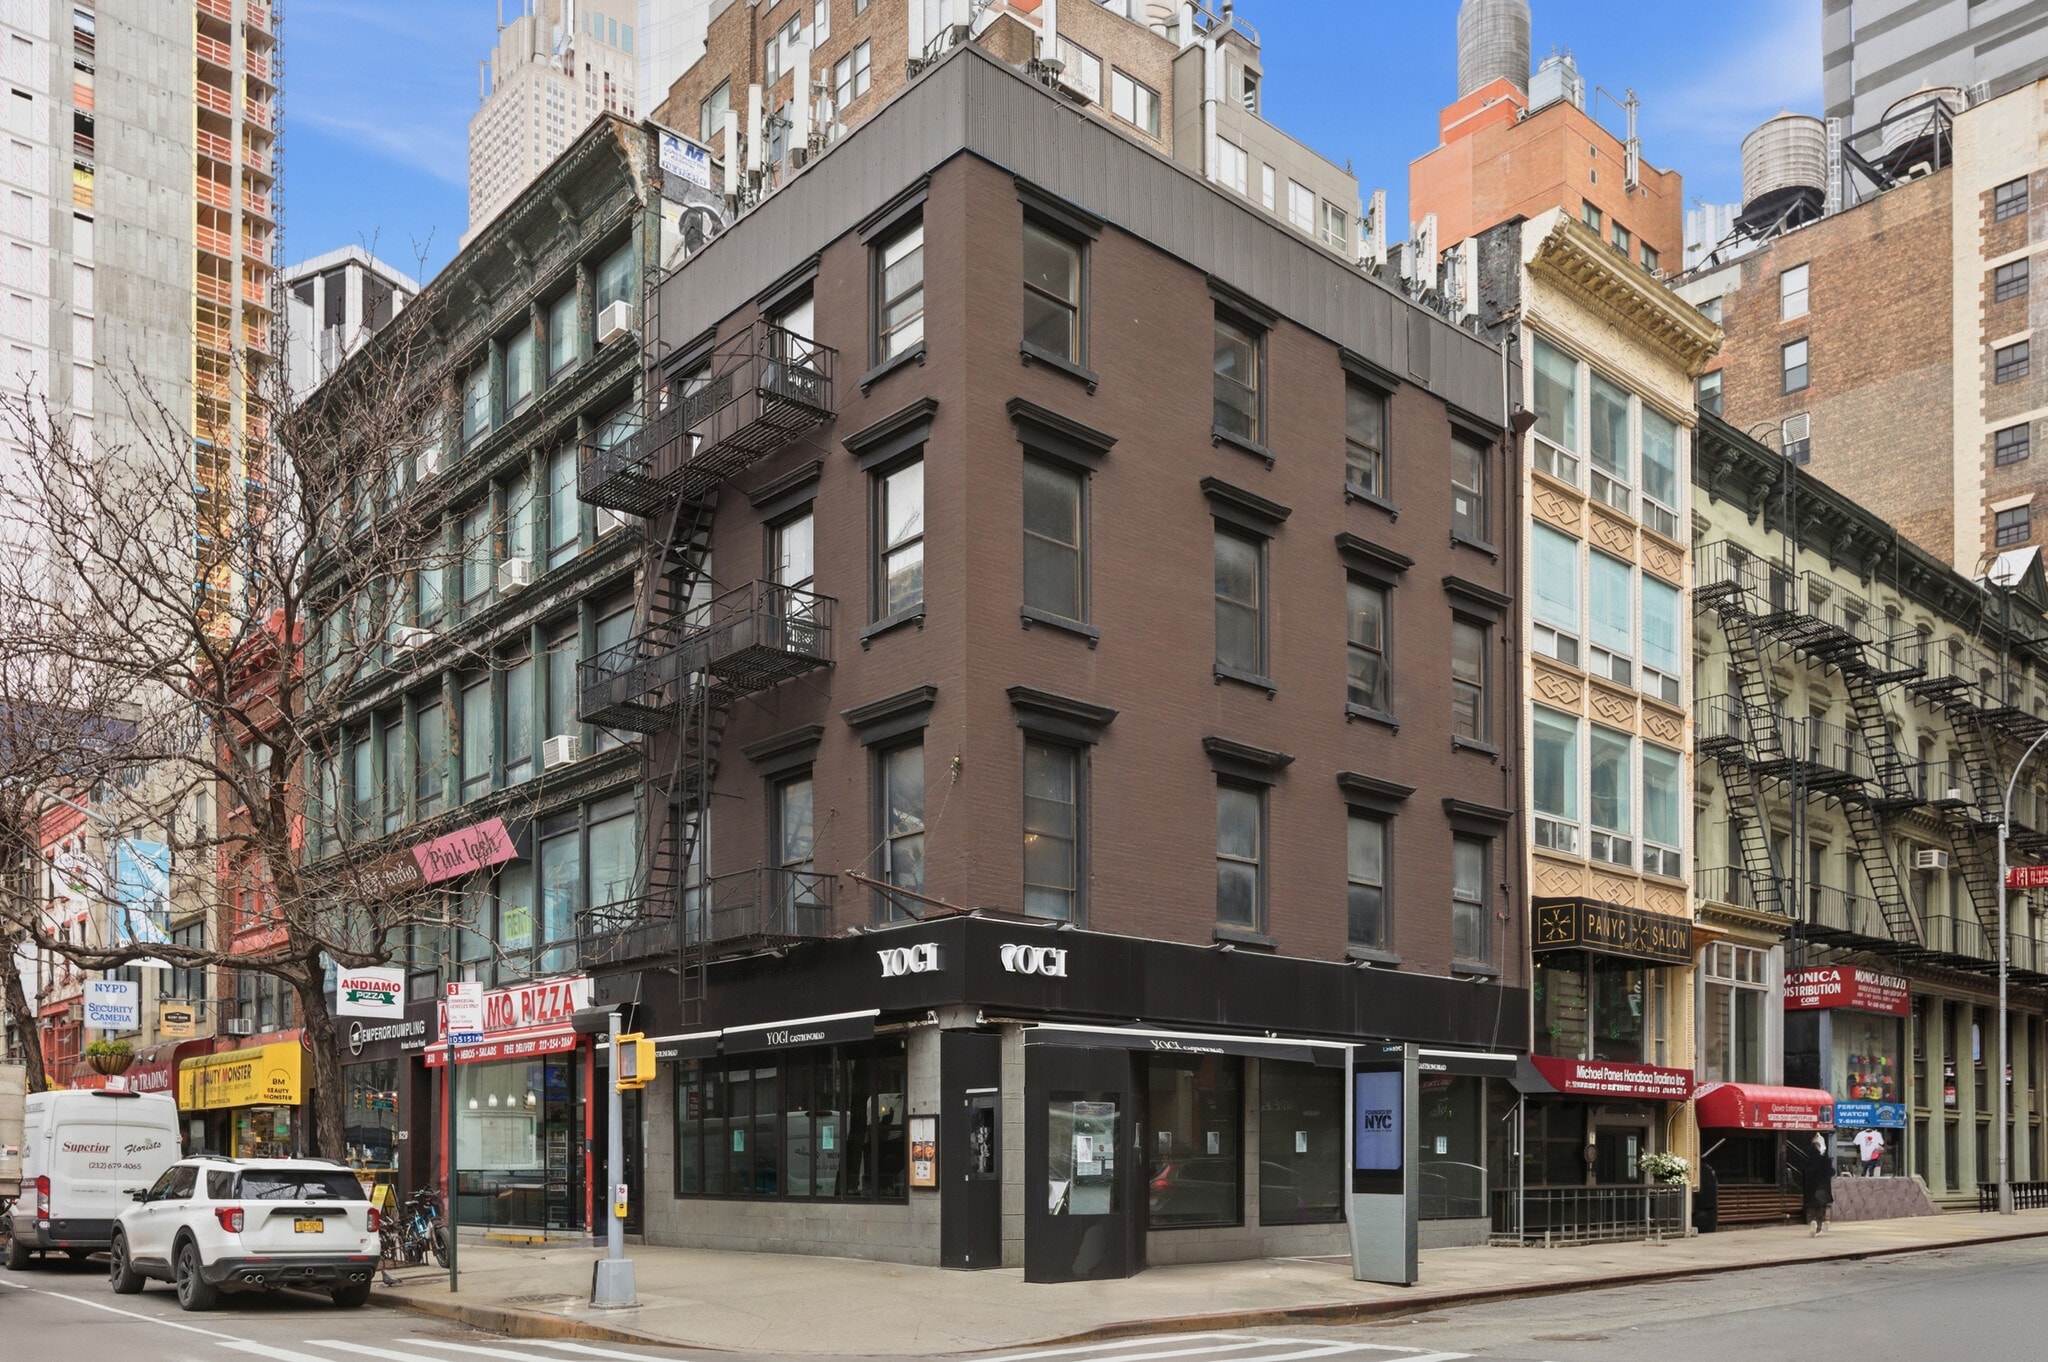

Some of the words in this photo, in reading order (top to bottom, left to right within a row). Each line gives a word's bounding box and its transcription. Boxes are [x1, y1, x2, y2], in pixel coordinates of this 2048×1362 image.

[429, 842, 465, 873] Pink
[1588, 913, 1626, 940] PANYC
[1652, 926, 1686, 949] SALON
[877, 943, 938, 978] YOGI
[1000, 943, 1068, 977] YOGI
[1783, 970, 1840, 985] MONICA
[1855, 970, 1879, 985] MONICA
[95, 983, 128, 993] NYPD
[341, 979, 402, 993] ANDIAMO
[450, 985, 456, 995] 3
[1783, 983, 1841, 997] DISTRIBUTION
[356, 991, 385, 1000] PIZZA
[521, 984, 575, 1022] PIZZA
[88, 1003, 133, 1012] SECURITY
[90, 1011, 132, 1022] CAMERA
[363, 1025, 392, 1042] EMPEROR
[392, 1020, 425, 1038] DUMPLING
[767, 1031, 789, 1045] YOGI
[503, 1043, 514, 1054] FREE
[515, 1040, 536, 1053] DELIVERY
[222, 1064, 252, 1084] MONSTER
[1576, 1065, 1603, 1080] Michael
[139, 1070, 168, 1091] TRADING
[1365, 1114, 1392, 1129] NYC
[63, 1141, 111, 1153] Superior
[124, 1140, 162, 1155] Florists
